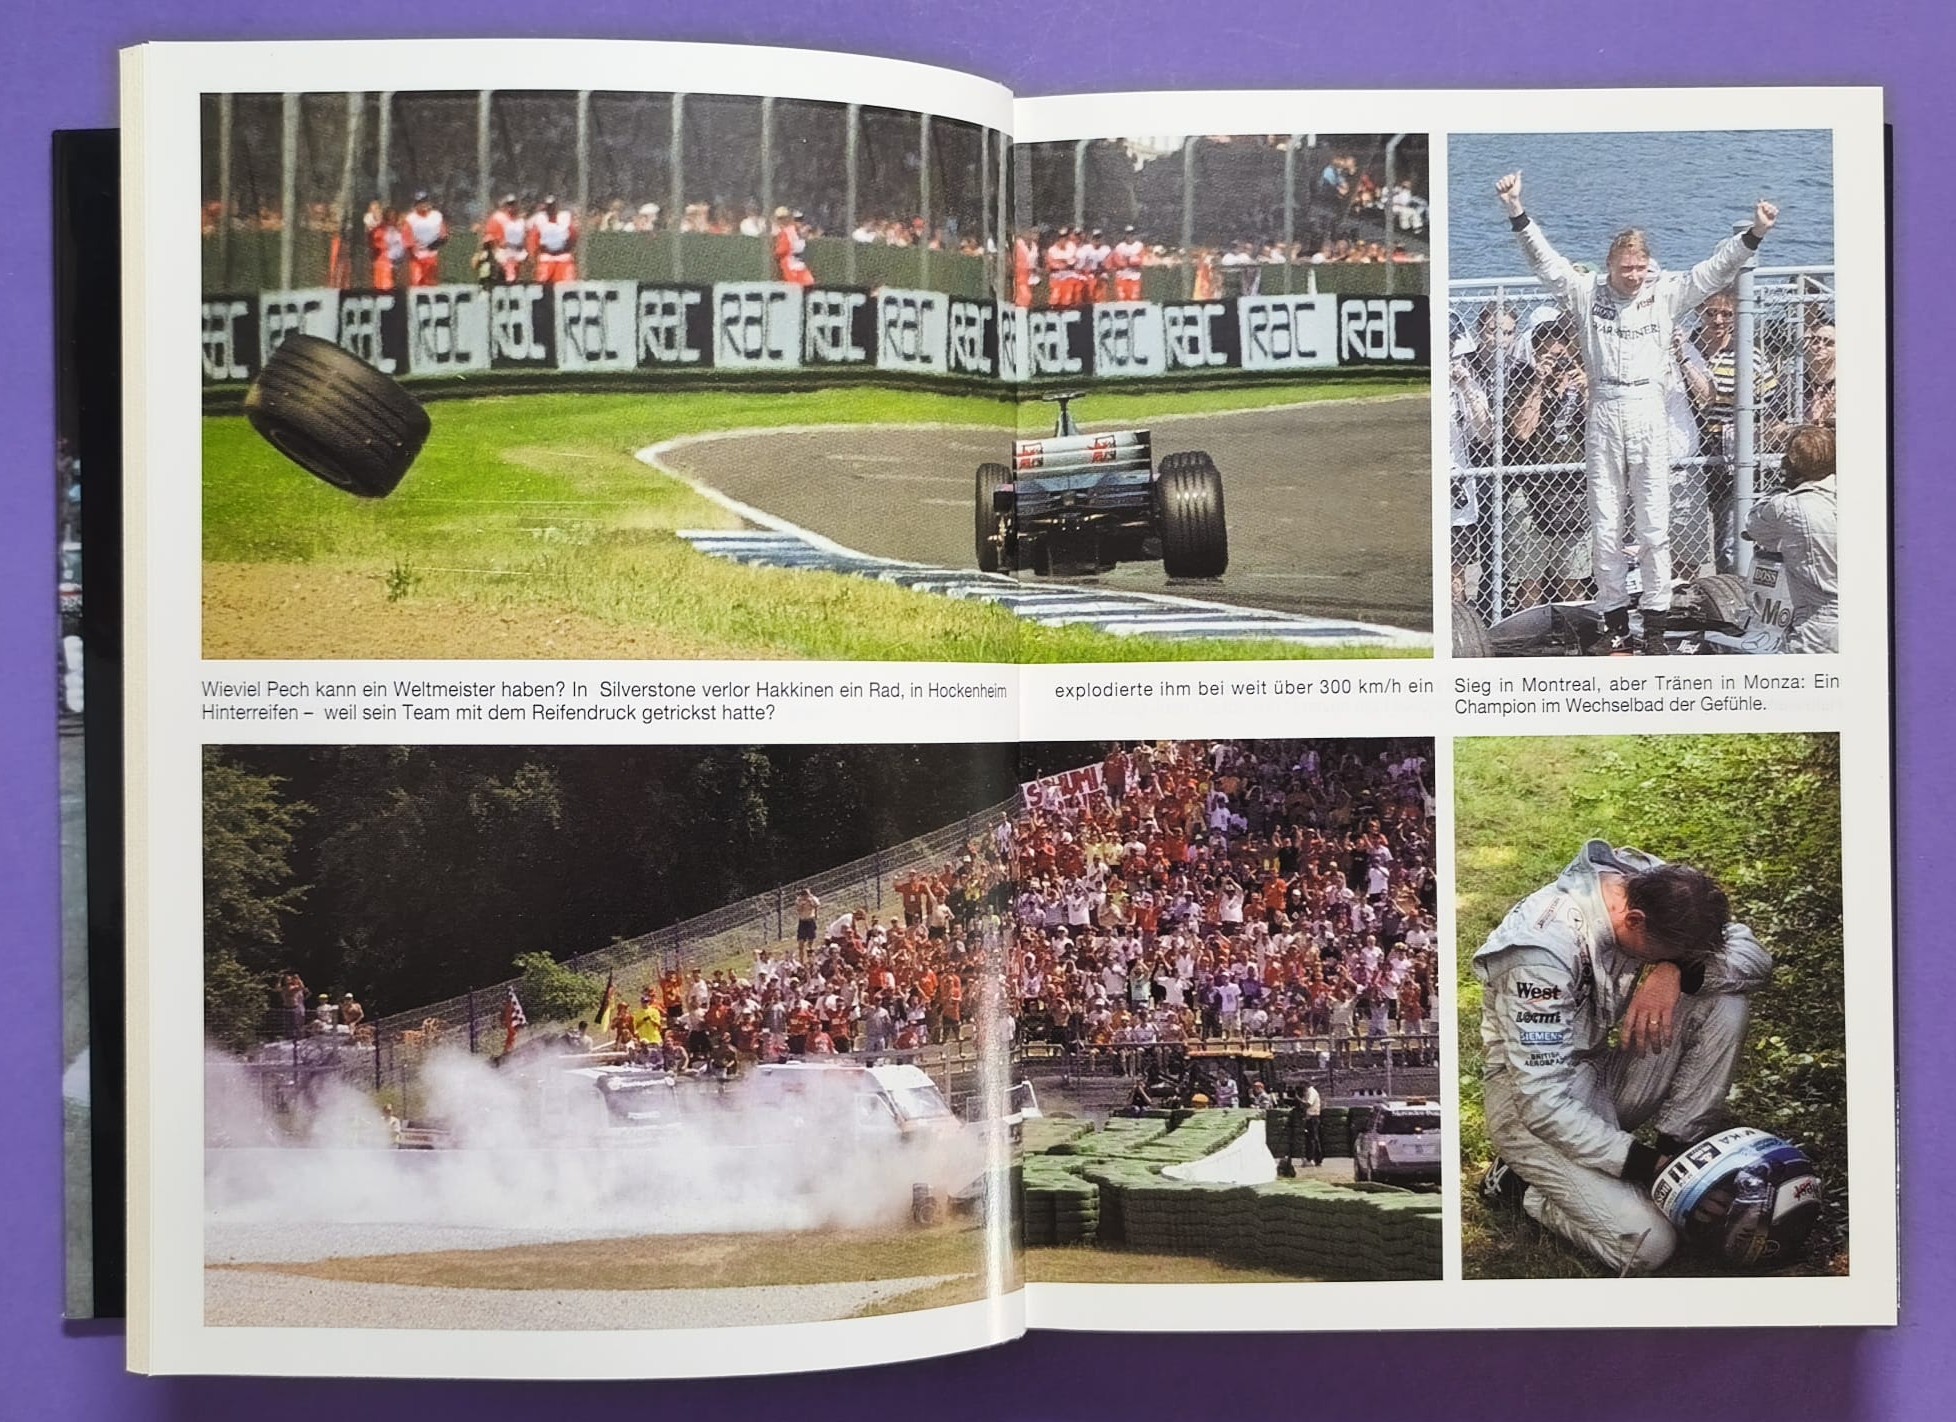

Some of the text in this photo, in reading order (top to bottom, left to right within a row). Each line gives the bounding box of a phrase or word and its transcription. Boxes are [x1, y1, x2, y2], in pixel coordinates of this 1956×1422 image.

[202, 681, 1006, 700] Wieviel Pech kann ein Weltmeister haben? In Silverstone verlor Hakkinen ein Rad, in Hockenheim
[1055, 678, 1433, 701] explodierte ihm bei weit über 300 km/h ein
[1455, 674, 1839, 696] Sieg in Montreal, aber Tränen in Monza: Ein
[203, 704, 298, 720] Hinterreifen
[324, 704, 356, 720] weil
[363, 704, 396, 720] sein
[402, 704, 449, 720] Team
[457, 704, 482, 720] mit
[488, 704, 525, 720] dem
[533, 704, 636, 720] Reifendruck
[642, 705, 716, 724] getrickst
[723, 704, 775, 720] hatte?
[1455, 696, 1766, 717] Champion im Wechselbad der Gefühle.
[1515, 982, 1562, 1000] West
